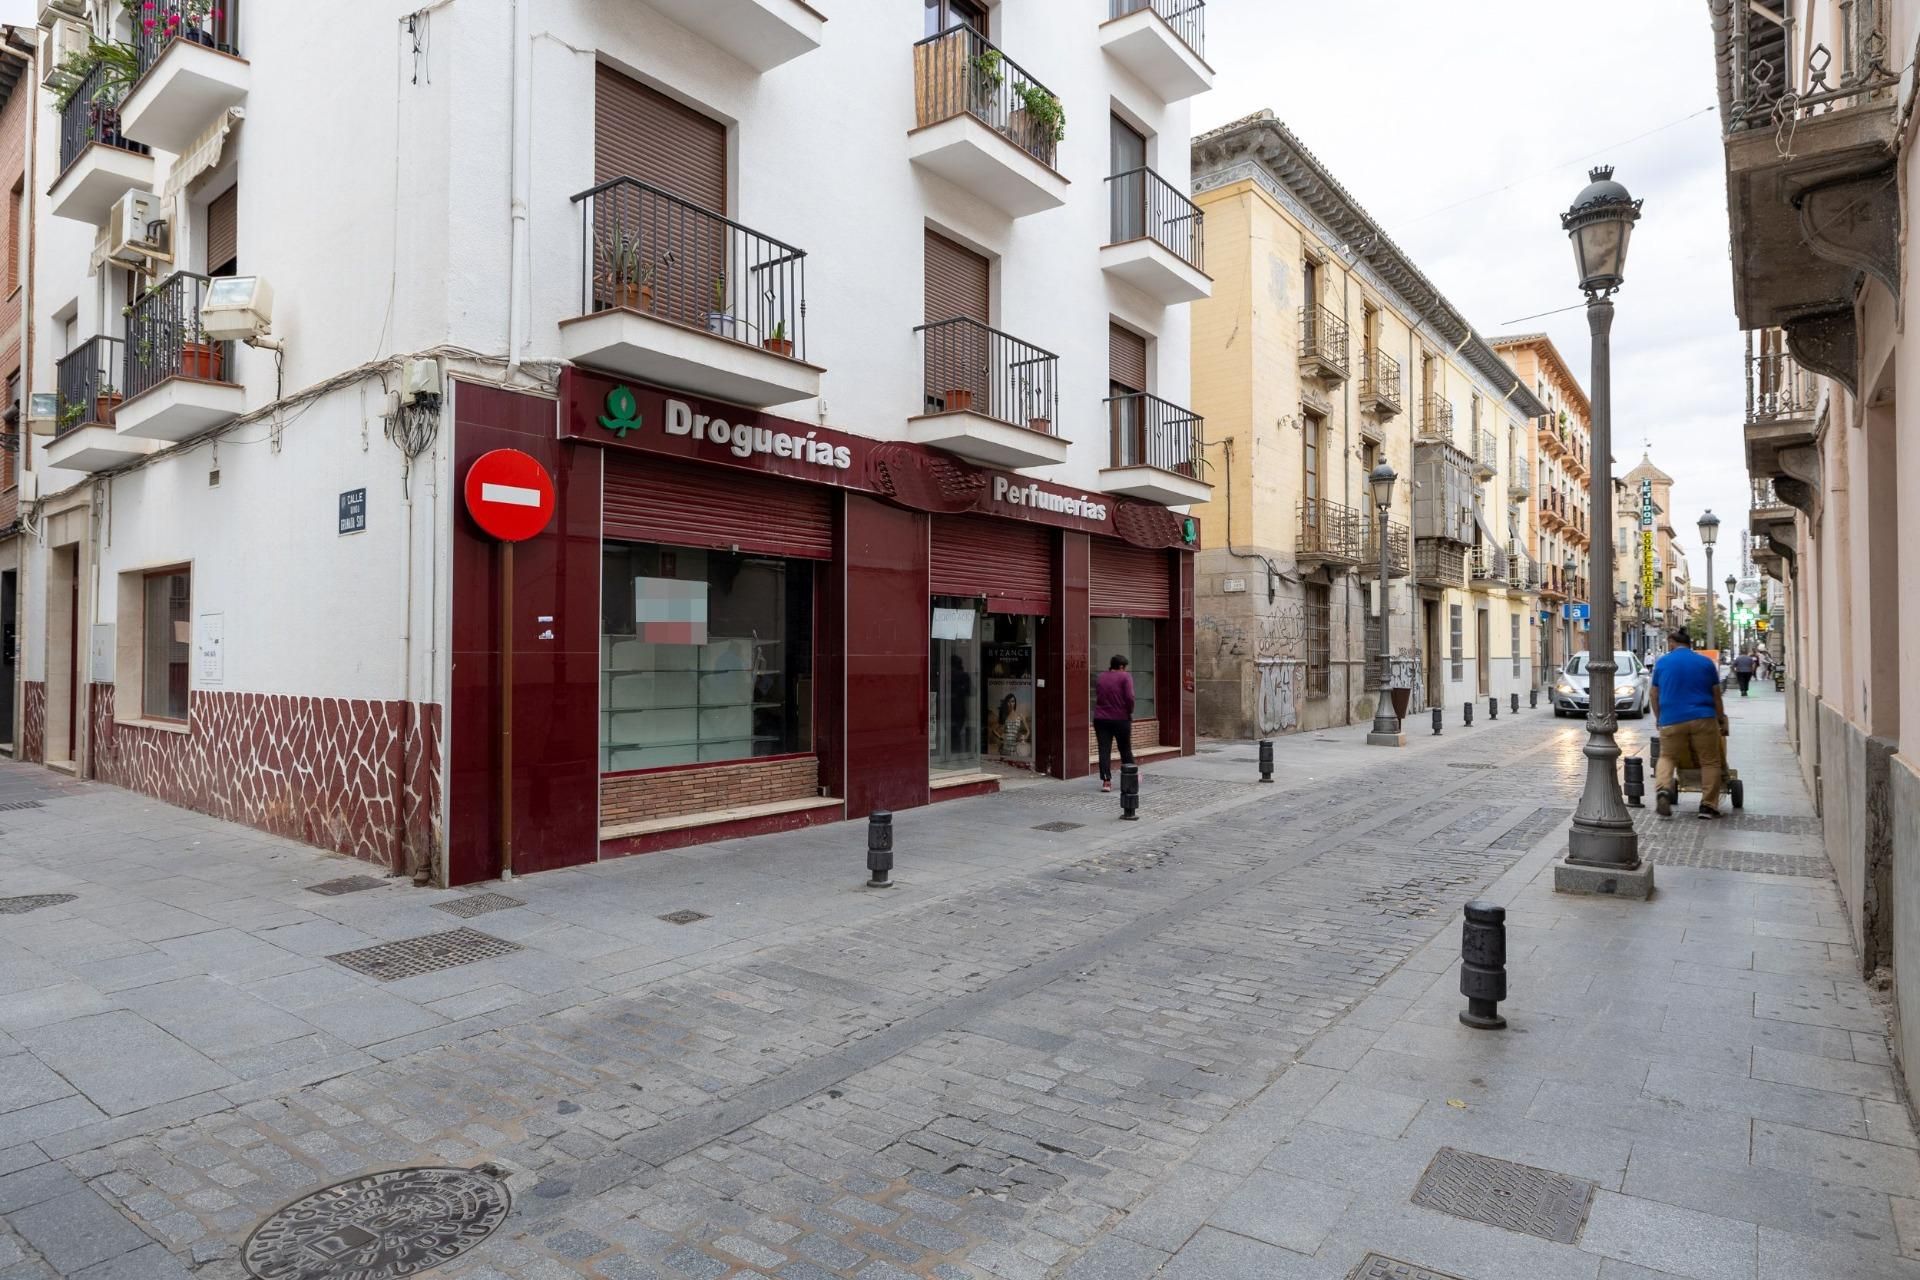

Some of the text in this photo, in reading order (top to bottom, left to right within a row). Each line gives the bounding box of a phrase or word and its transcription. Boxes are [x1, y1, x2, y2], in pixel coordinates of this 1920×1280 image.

[665, 398, 852, 470] Droguerías
[347, 492, 363, 504] CALLE
[993, 476, 1107, 522] Perfumerías
[1643, 479, 1651, 525] TEJIDOS
[1643, 533, 1652, 607] CONFECCIONES
